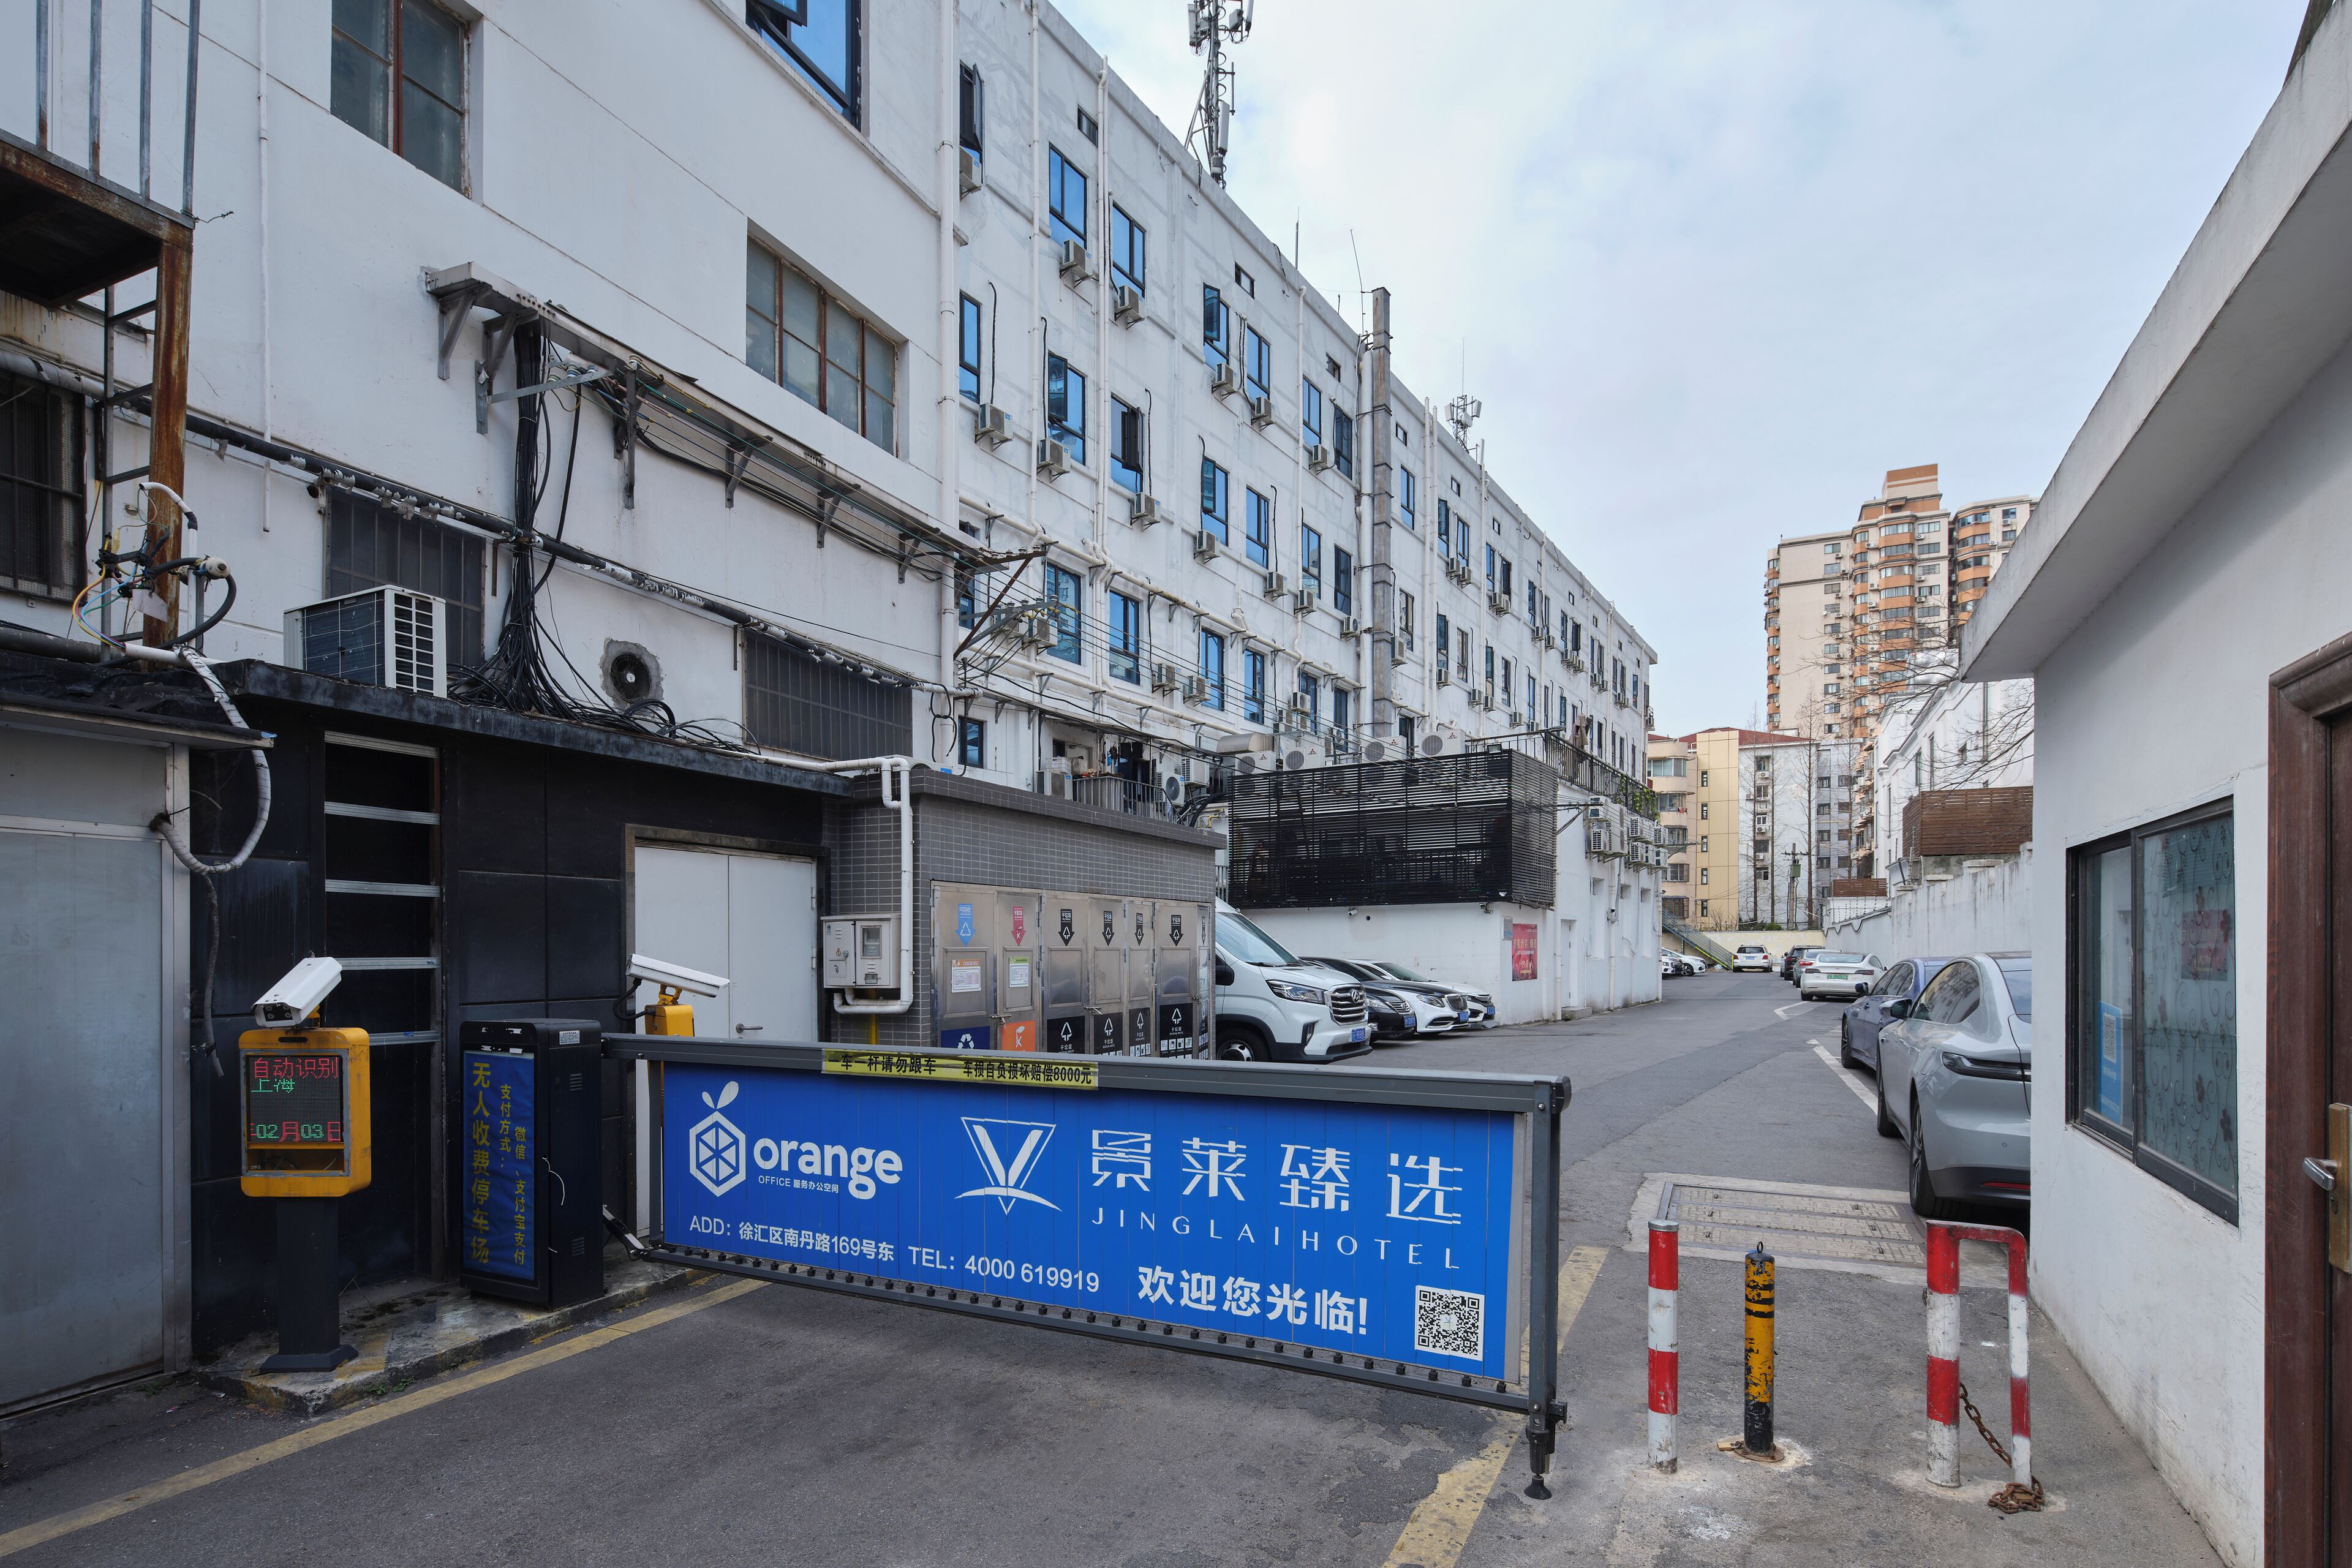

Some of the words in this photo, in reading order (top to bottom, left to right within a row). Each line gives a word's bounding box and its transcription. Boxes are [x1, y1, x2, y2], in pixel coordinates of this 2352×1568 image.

[255, 1057, 339, 1079] 自动识别
[827, 1054, 937, 1075] 一车一杆请勿跟车
[963, 1060, 1092, 1084] 车损自负损坏赔偿8000元
[470, 1061, 491, 1264] 无人收费停车场
[514, 1126, 527, 1265] 微信、支付宝支付
[753, 1137, 903, 1200] orange
[758, 1175, 790, 1187] OFFICE
[793, 1178, 839, 1193] 服务办公空间
[739, 1221, 894, 1262] 徐汇区南丹路169号东
[965, 1255, 1015, 1280] 4000
[1021, 1263, 1099, 1292] 619919
[1137, 1265, 1367, 1335] 欢迎您光临!
